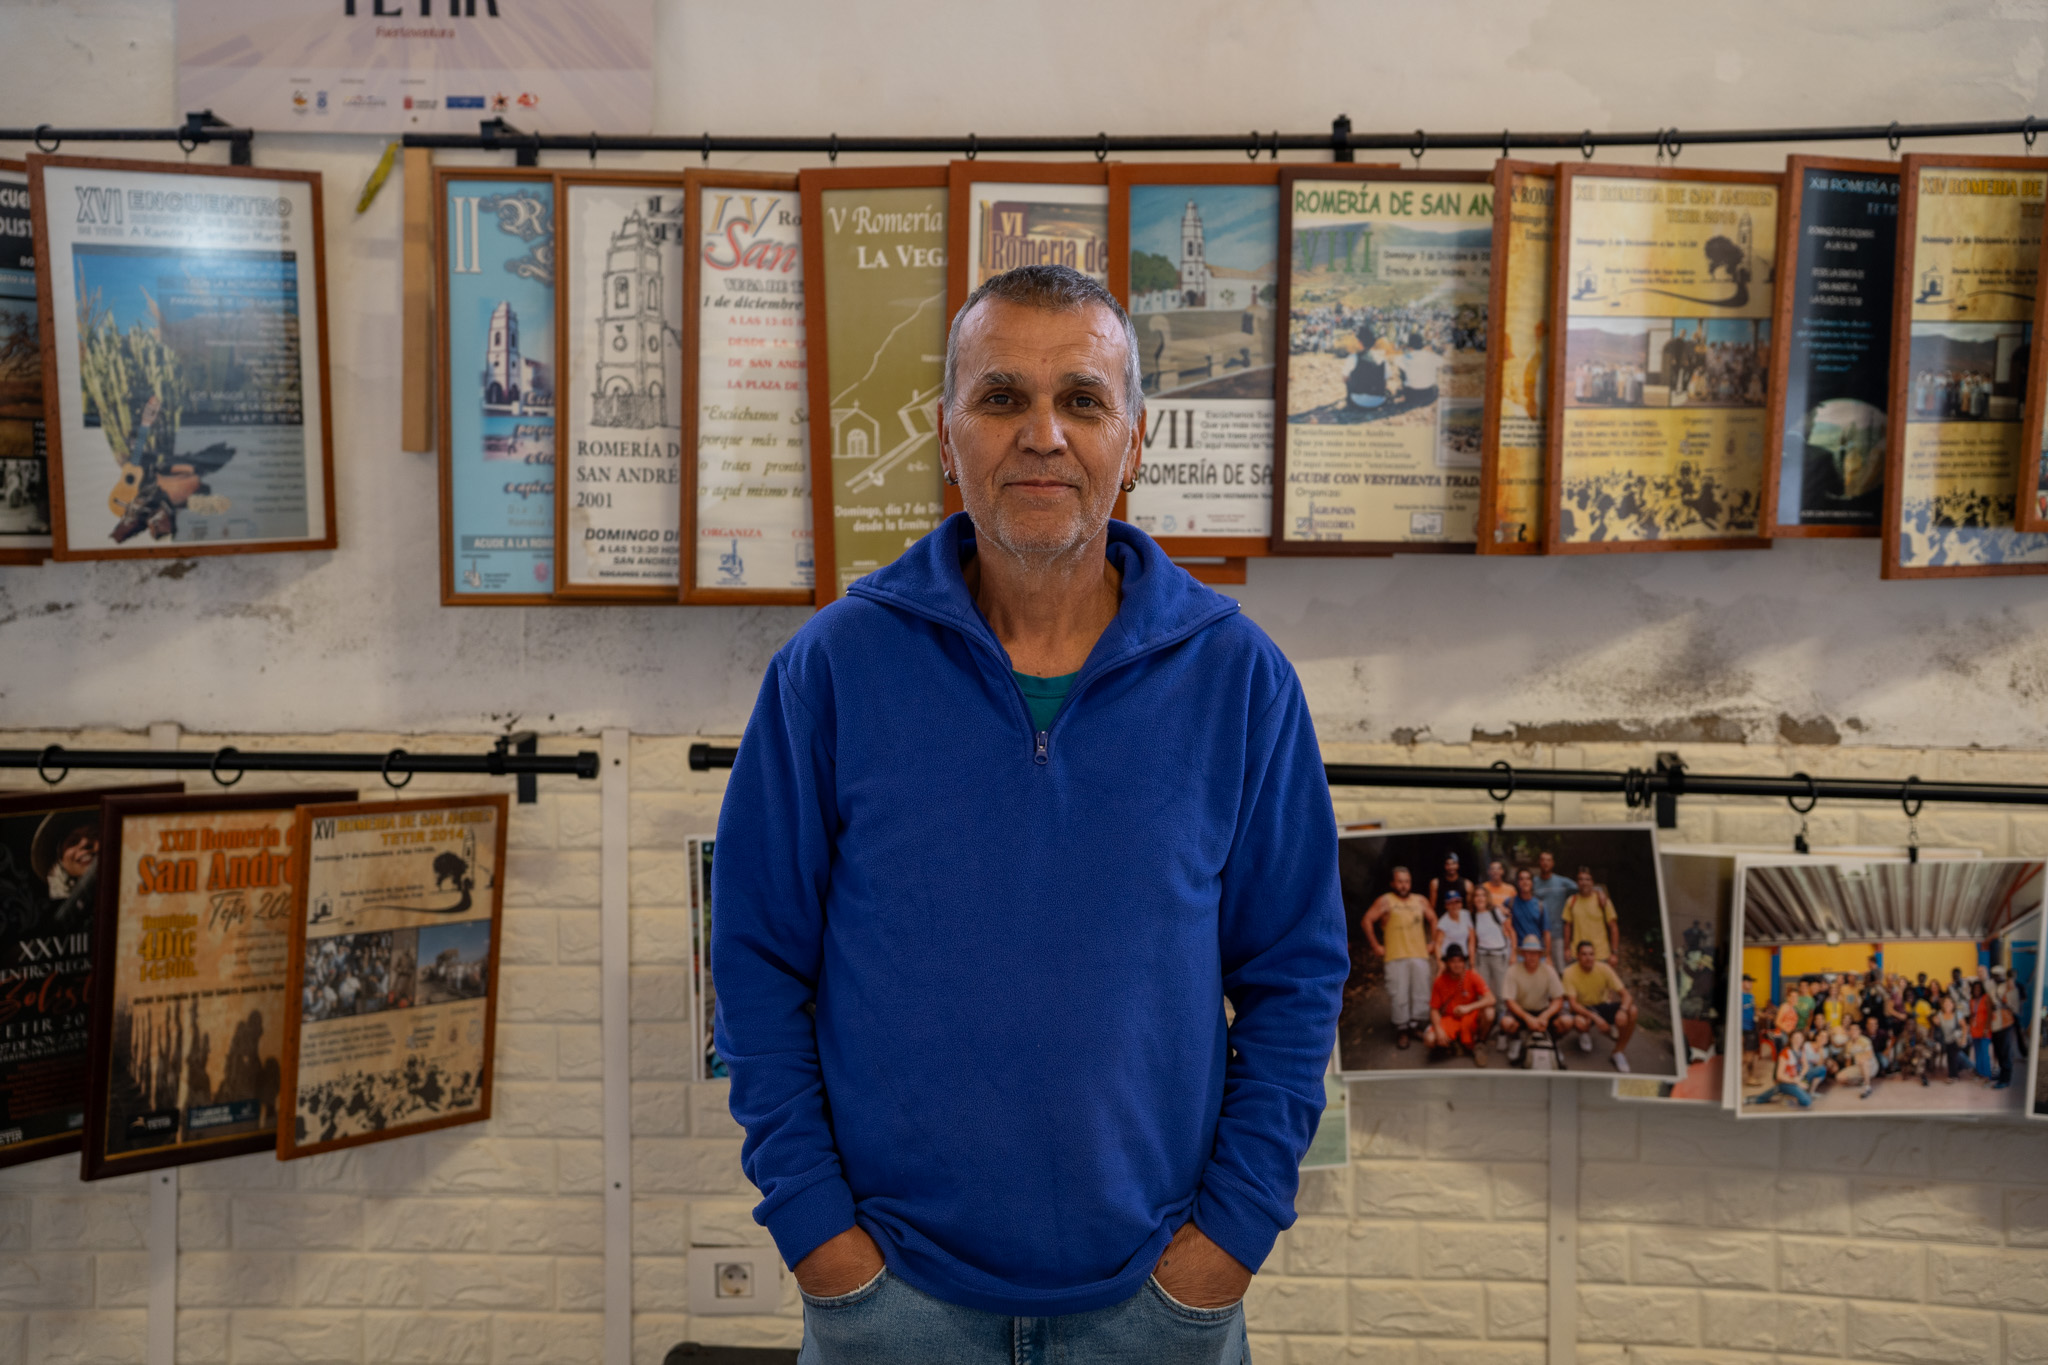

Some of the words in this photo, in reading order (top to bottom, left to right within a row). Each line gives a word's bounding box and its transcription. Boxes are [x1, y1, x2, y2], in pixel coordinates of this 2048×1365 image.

[76, 186, 123, 225] XVI
[128, 190, 292, 218] ENCUENTRO
[1295, 183, 1381, 215] ROMERÍA
[1390, 191, 1414, 216] DE
[1420, 193, 1461, 216] SAN
[705, 194, 780, 238] IV
[828, 206, 847, 235] V
[852, 204, 944, 235] Romería
[1001, 211, 1024, 237] VI
[453, 197, 482, 275] II
[704, 217, 798, 274] San
[857, 246, 890, 269] LA
[1297, 230, 1374, 273] VIII
[715, 296, 731, 308] de
[577, 436, 662, 458] ROMERÍA
[576, 465, 611, 483] SAN
[1137, 458, 1217, 485] ROMERÍA
[1223, 463, 1245, 485] DE
[1288, 471, 1331, 485] ACUDE
[1334, 472, 1360, 485] CON
[576, 491, 613, 509] 2001
[584, 527, 660, 542] DOMINGO
[201, 823, 281, 850] Romería
[314, 819, 335, 841] XVI
[380, 830, 426, 846] TETIR
[429, 827, 465, 843] 2014
[137, 854, 198, 895] San
[18, 931, 89, 962] XXVIII
